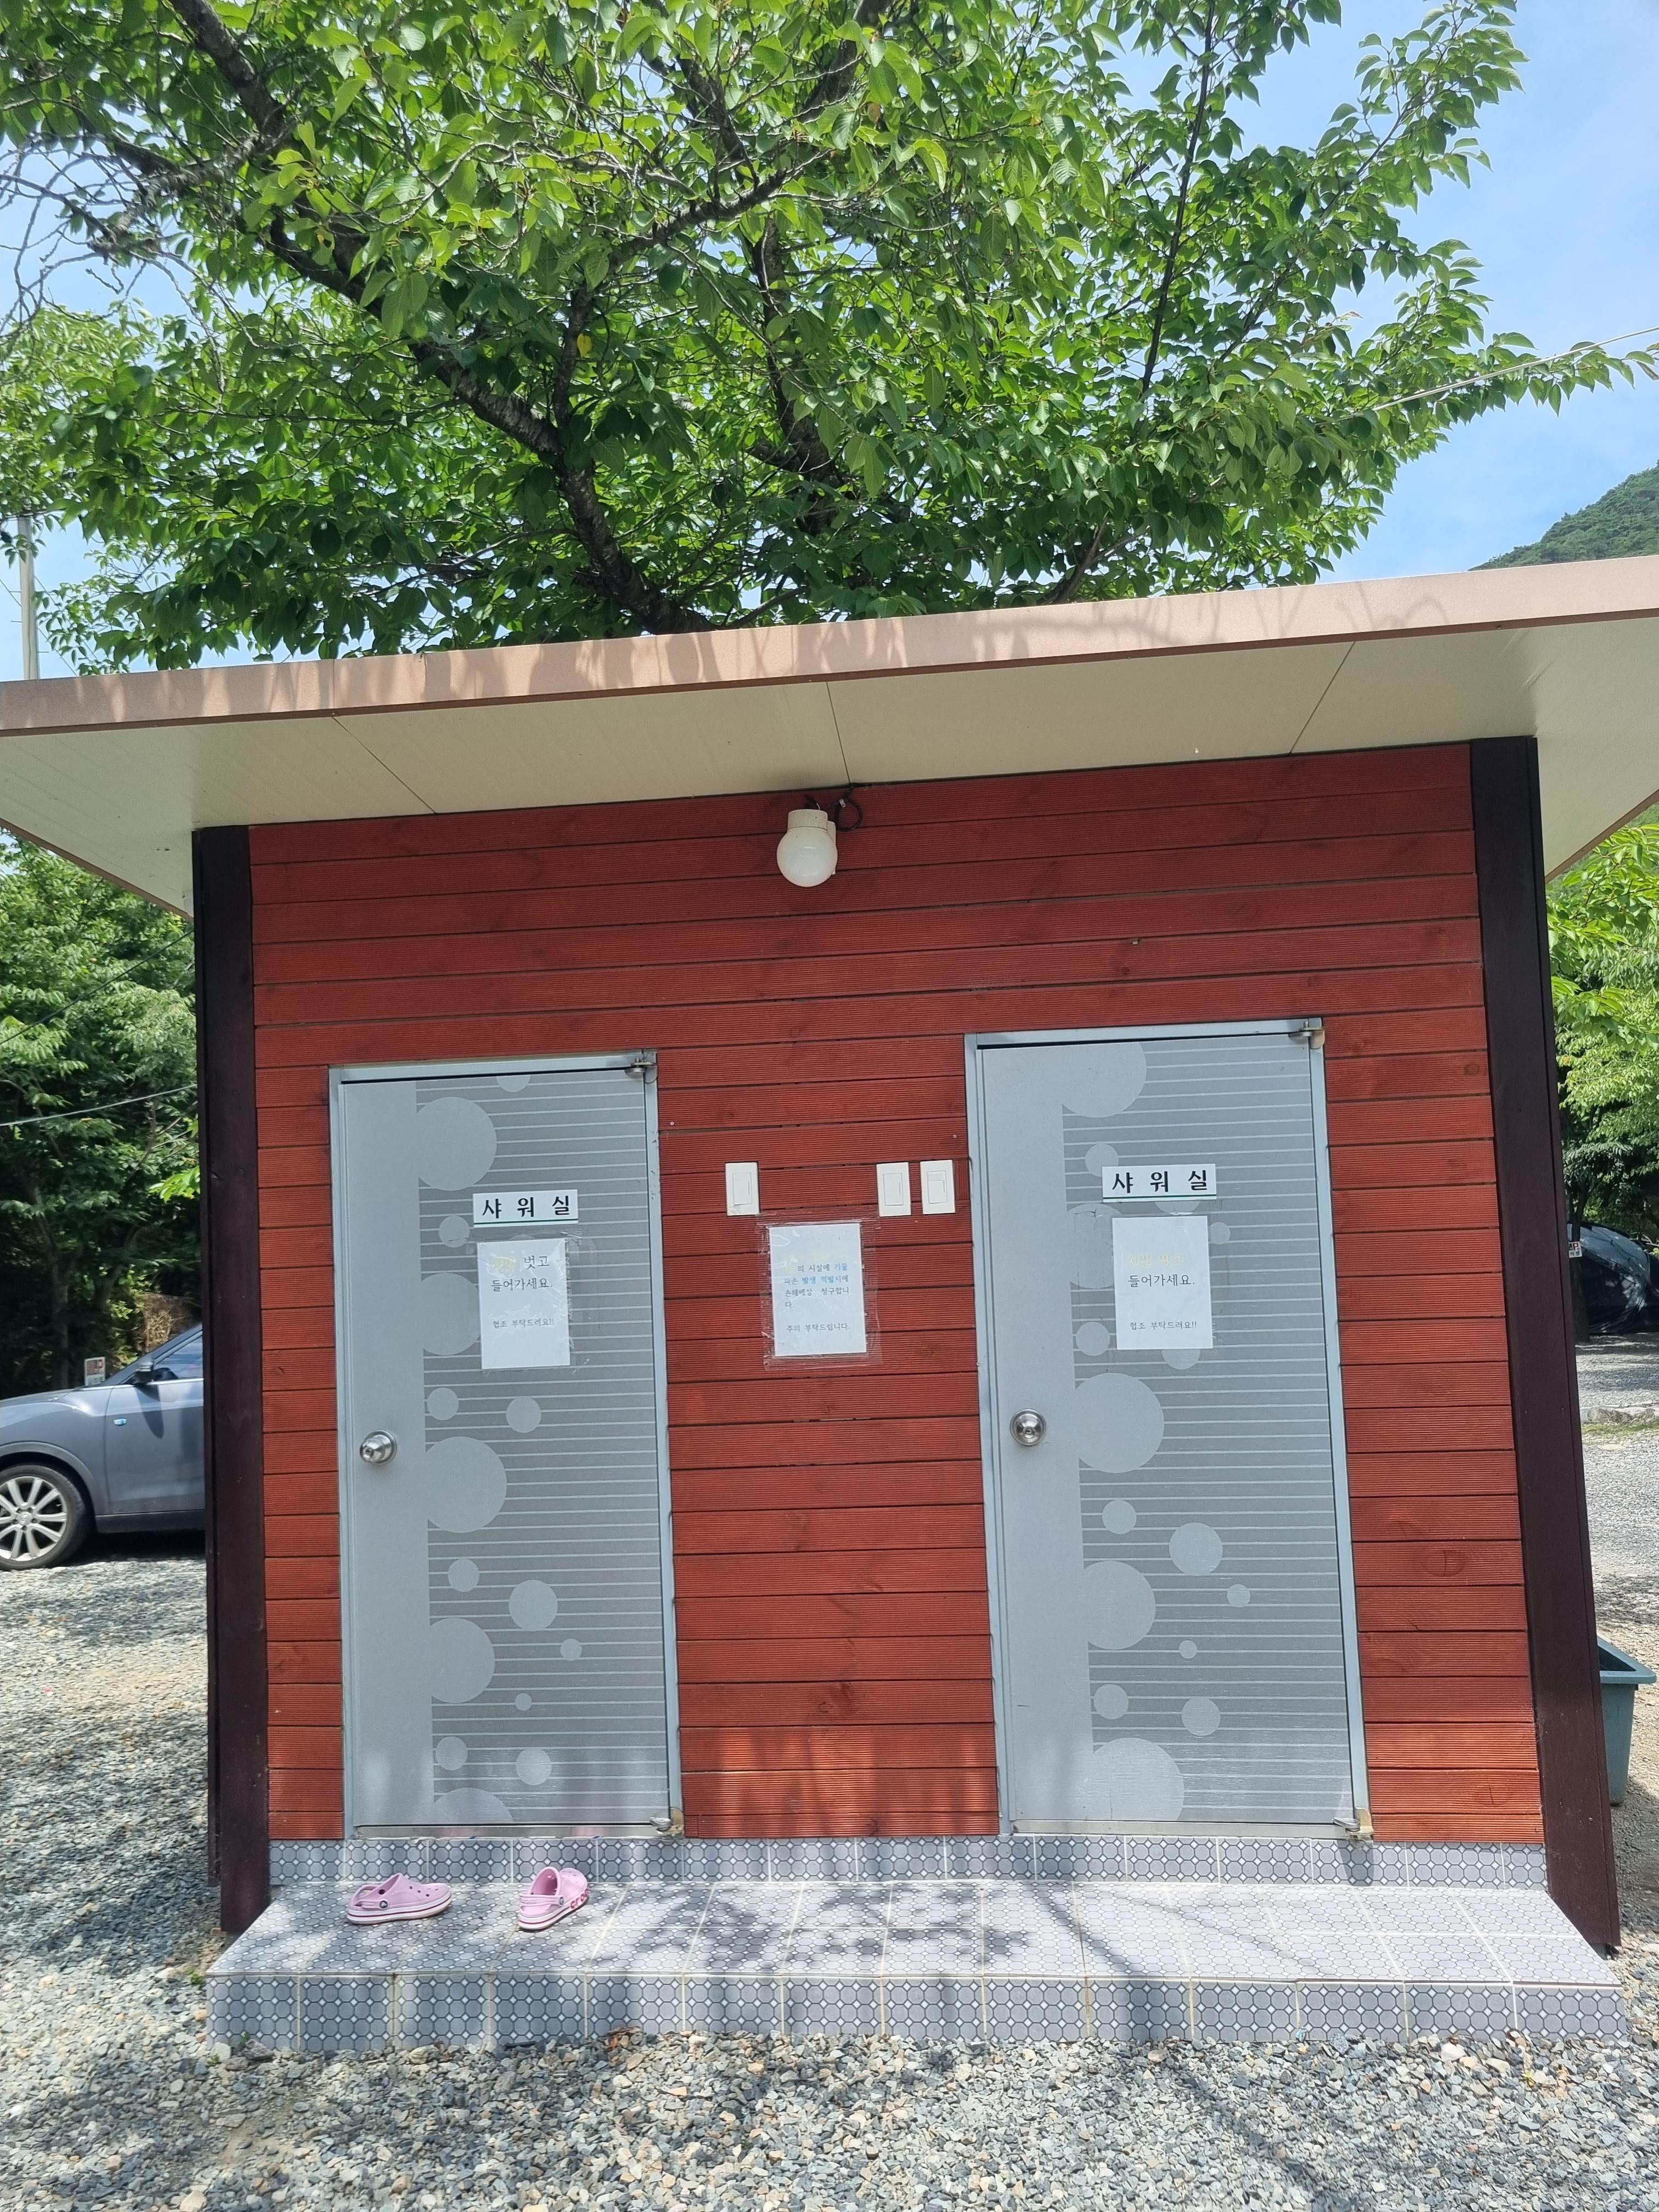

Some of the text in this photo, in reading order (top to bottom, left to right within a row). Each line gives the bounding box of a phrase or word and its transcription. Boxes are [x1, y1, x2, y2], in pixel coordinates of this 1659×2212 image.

[523, 1255, 550, 1269] 벗고
[491, 1277, 554, 1292] 들어가세요.
[1127, 1273, 1195, 1288] 들어가세요.
[786, 1324, 800, 1333] 주의
